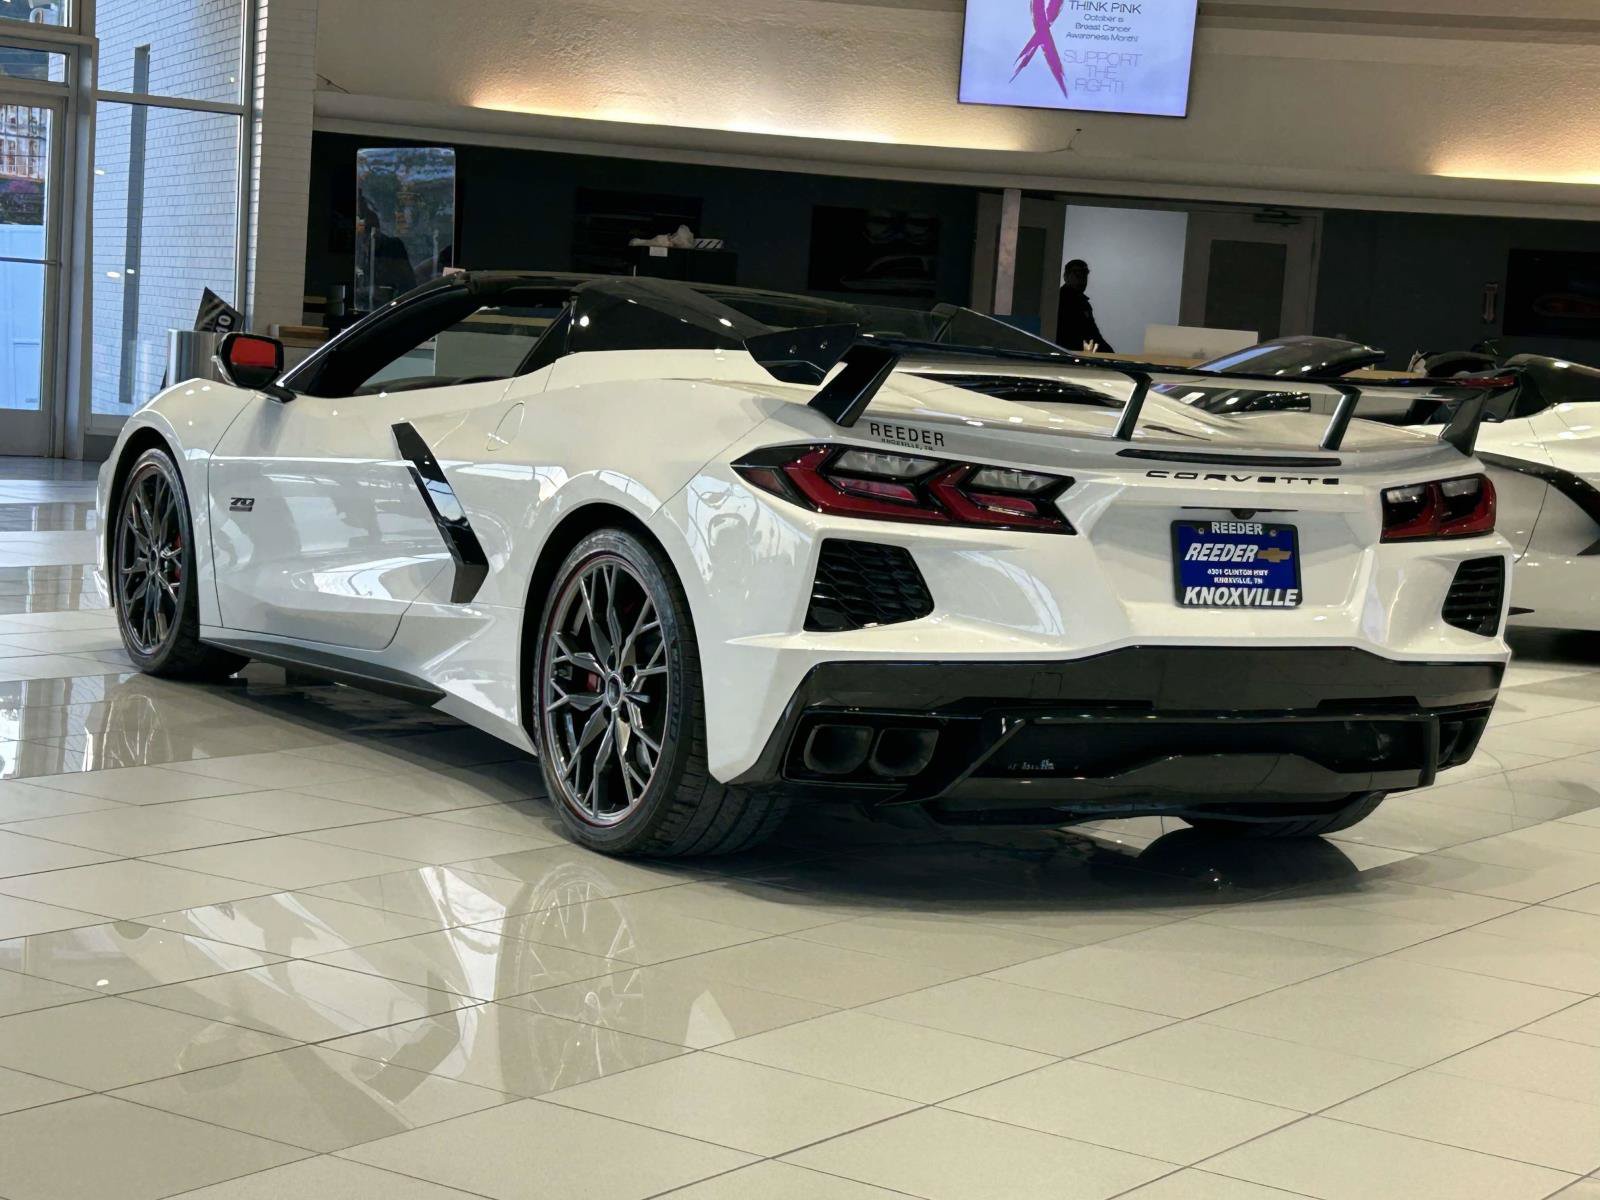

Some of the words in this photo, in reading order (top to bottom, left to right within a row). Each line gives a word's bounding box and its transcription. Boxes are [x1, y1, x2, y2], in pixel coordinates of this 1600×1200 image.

[1069, 0, 1108, 12] THINK
[1111, 2, 1142, 14] PINK
[1083, 13, 1116, 22] October
[1075, 22, 1101, 31] Breast
[1102, 24, 1132, 33] Cancer
[1066, 31, 1110, 41] Awareness
[1063, 49, 1143, 67] SUPPORT
[1086, 64, 1117, 80] THE
[870, 423, 944, 446] REEDER
[1146, 470, 1339, 485] CORVETTE
[1211, 521, 1263, 535] REEDER
[1184, 542, 1259, 562] REEDER
[1183, 586, 1299, 606] KNOXVILLE
